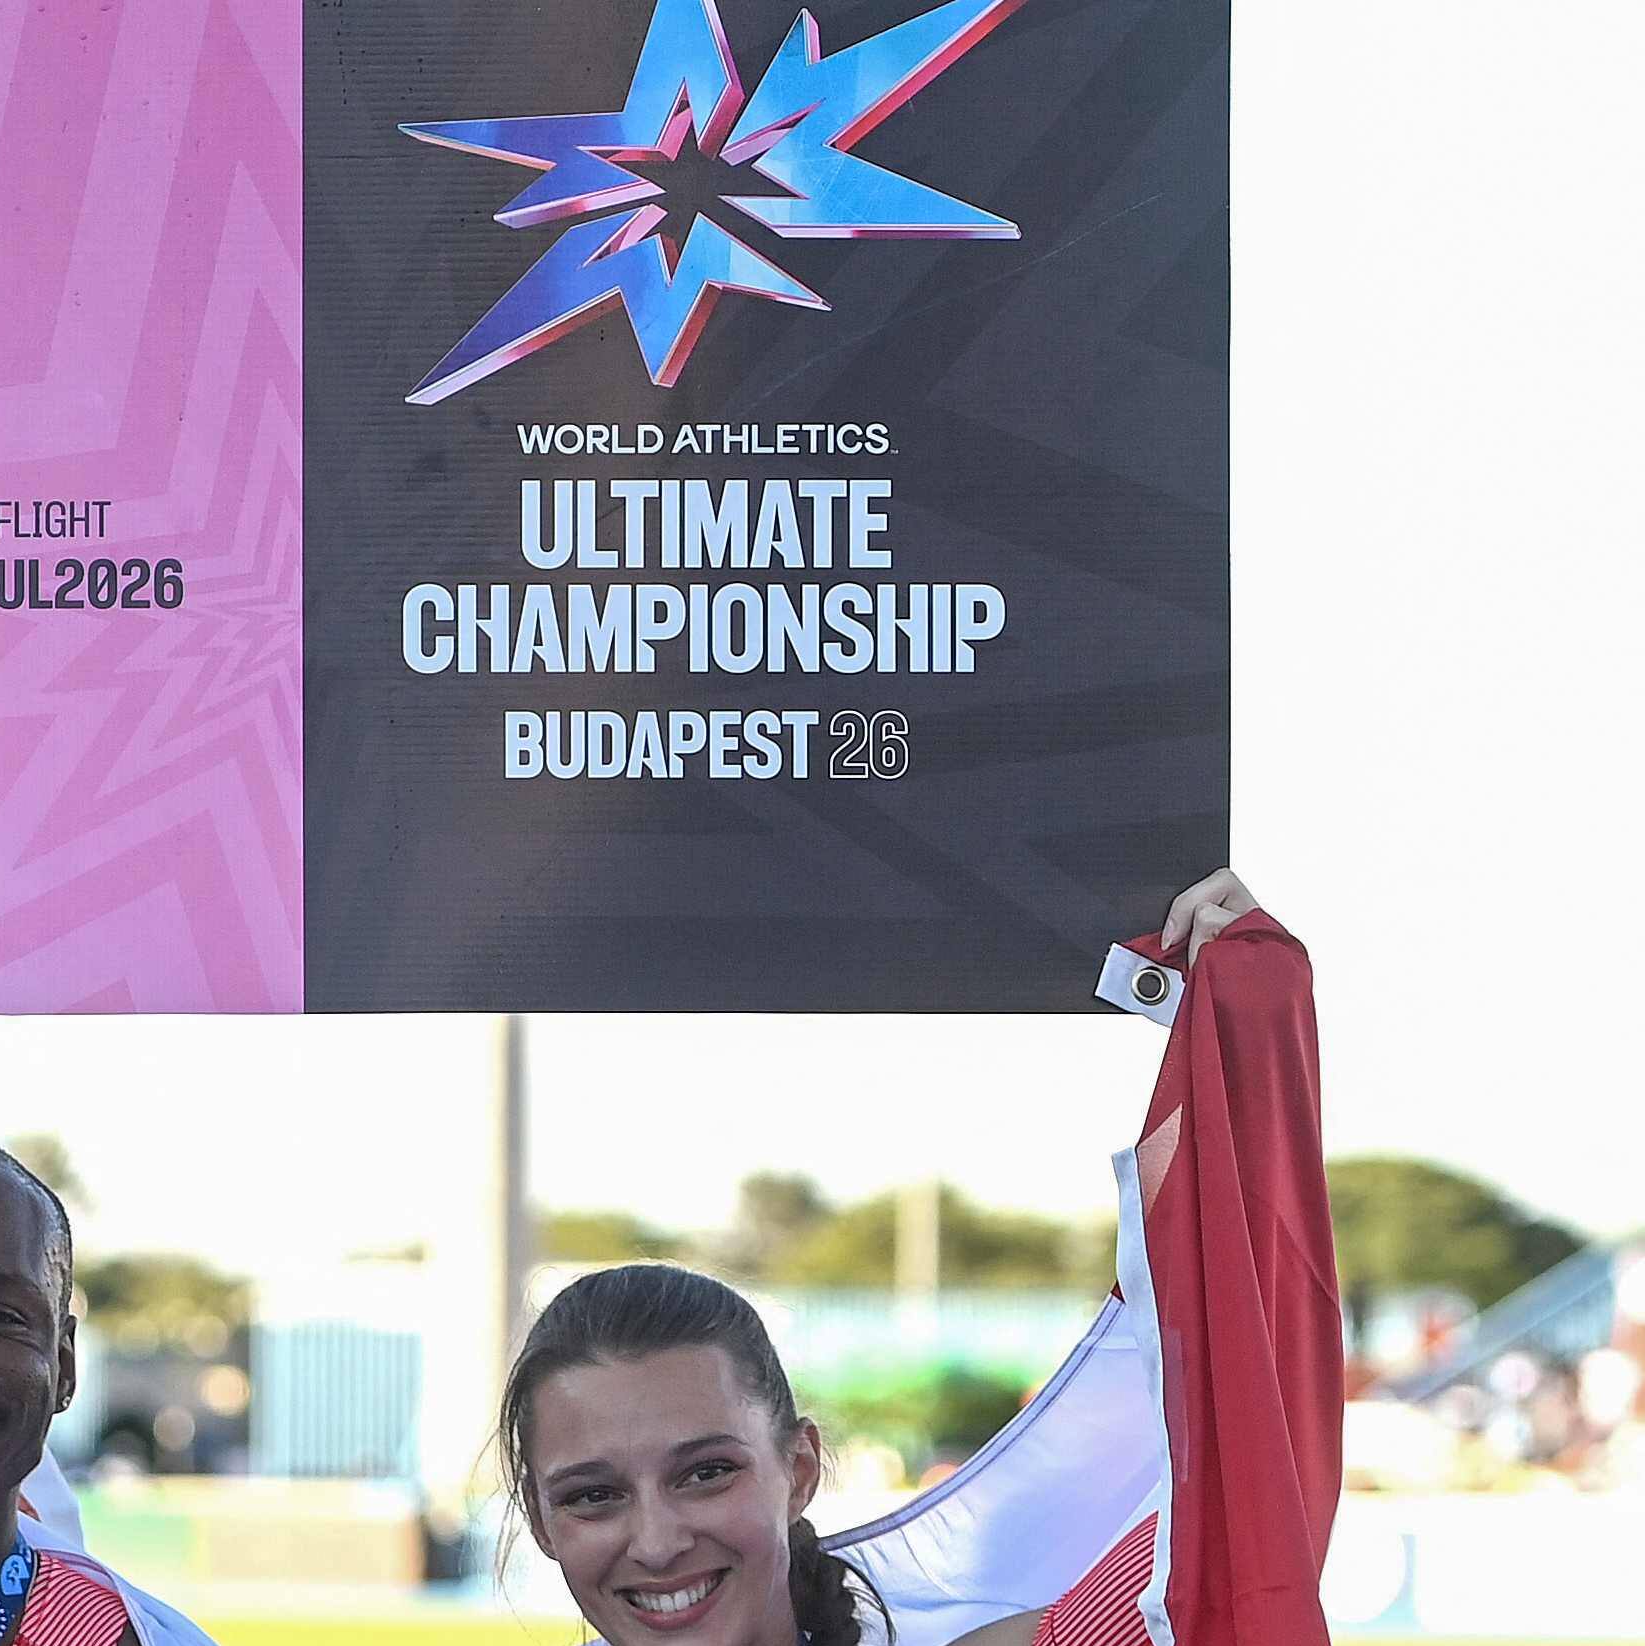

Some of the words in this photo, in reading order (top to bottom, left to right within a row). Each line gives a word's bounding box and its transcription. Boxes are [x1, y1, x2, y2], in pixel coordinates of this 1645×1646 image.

[518, 424, 663, 454] WORLD
[672, 424, 888, 454] ATHLETICS
[522, 480, 891, 569] ULTIMATE
[403, 583, 1005, 673] CHAMPIONSHIP
[505, 711, 818, 778] BUDAPEST
[830, 711, 908, 779] 26
